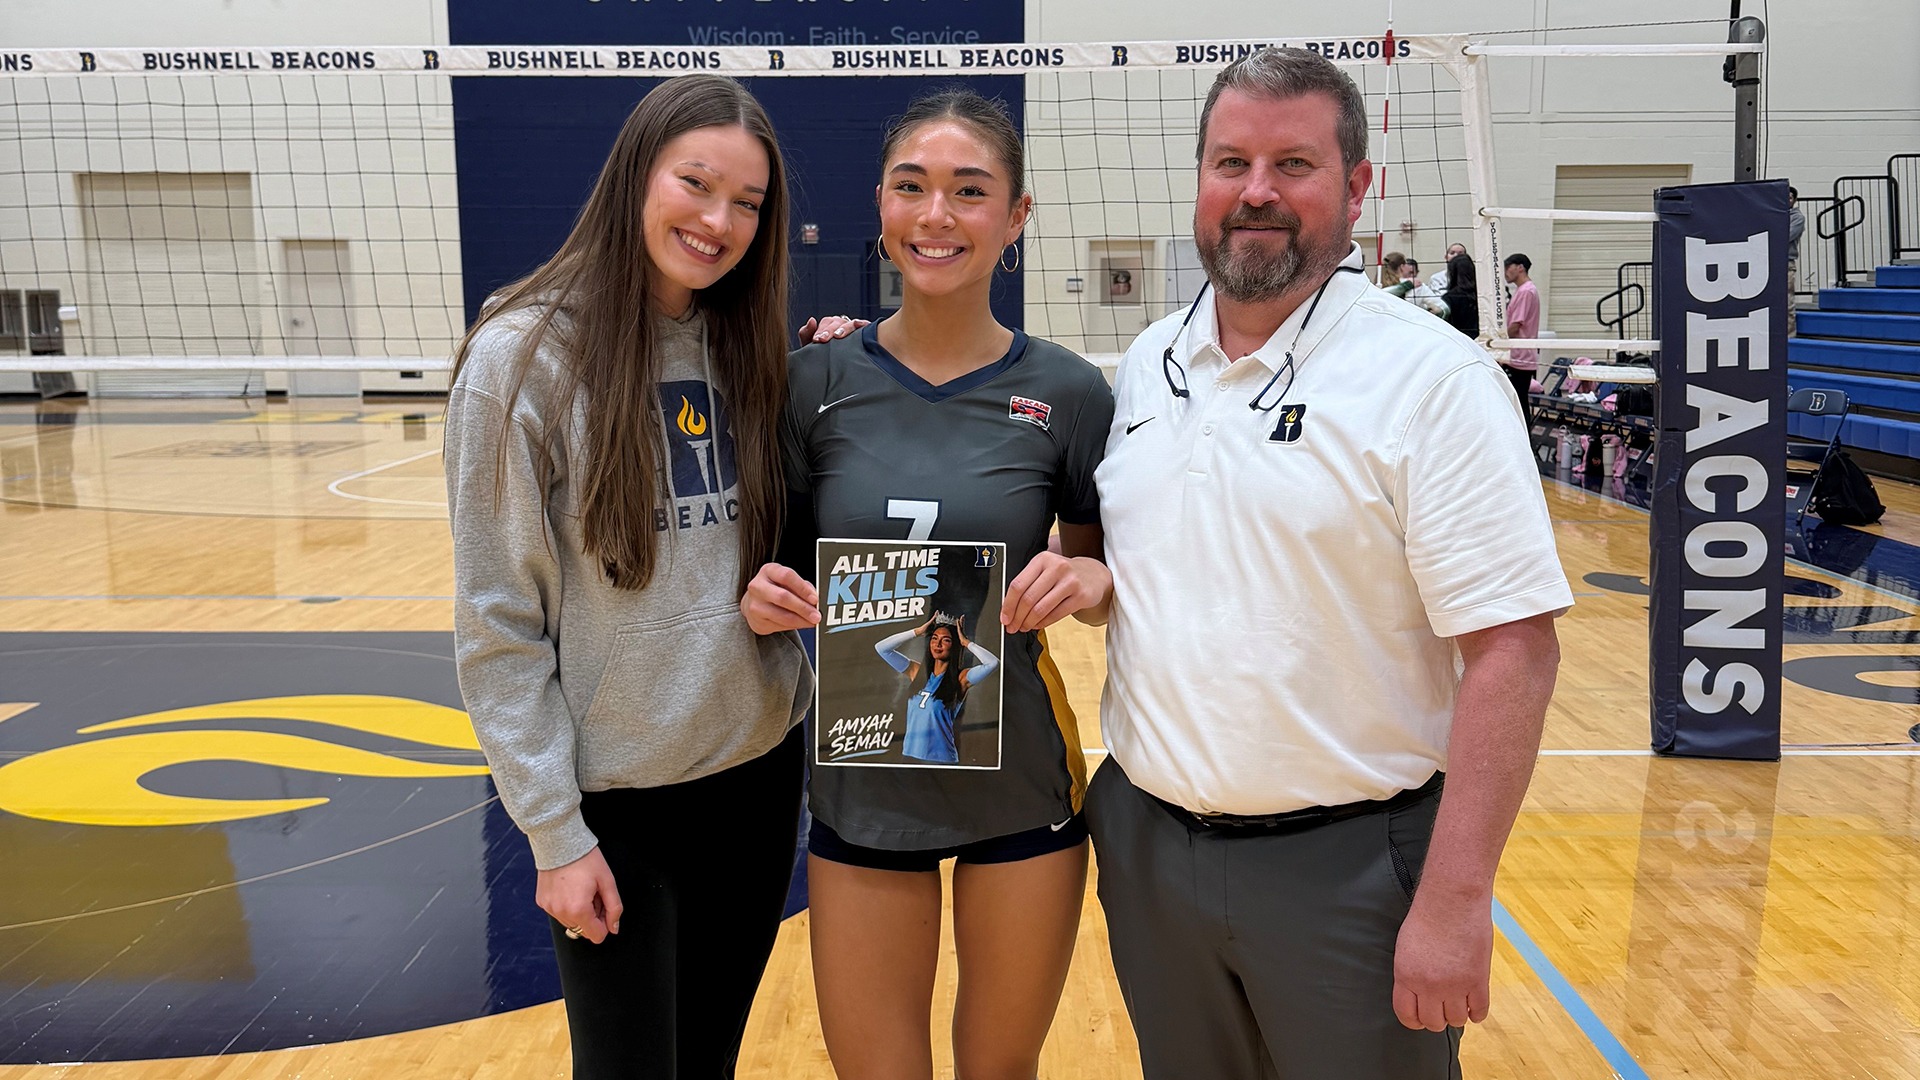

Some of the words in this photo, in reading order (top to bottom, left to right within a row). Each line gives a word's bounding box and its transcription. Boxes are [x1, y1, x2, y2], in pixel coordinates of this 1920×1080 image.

[688, 26, 784, 46] Wisdom
[810, 26, 867, 45] Faith
[890, 25, 980, 45] Service
[143, 52, 260, 70] BUSHNELL
[270, 51, 376, 69] BEACONS
[487, 51, 605, 69] BUSHNELL
[616, 51, 721, 69] BEACONS
[832, 50, 948, 68] BUSHNELL
[960, 48, 1064, 67] BEACONS
[1683, 231, 1769, 715] BEACONS
[885, 497, 941, 541] 7
[830, 554, 879, 575] ALL
[884, 548, 941, 570] TIME
[827, 566, 939, 604] KILLS
[827, 597, 926, 626] LEADER
[919, 690, 931, 709] 7
[828, 713, 893, 737] AMYAH
[829, 732, 894, 756] SEMAU
